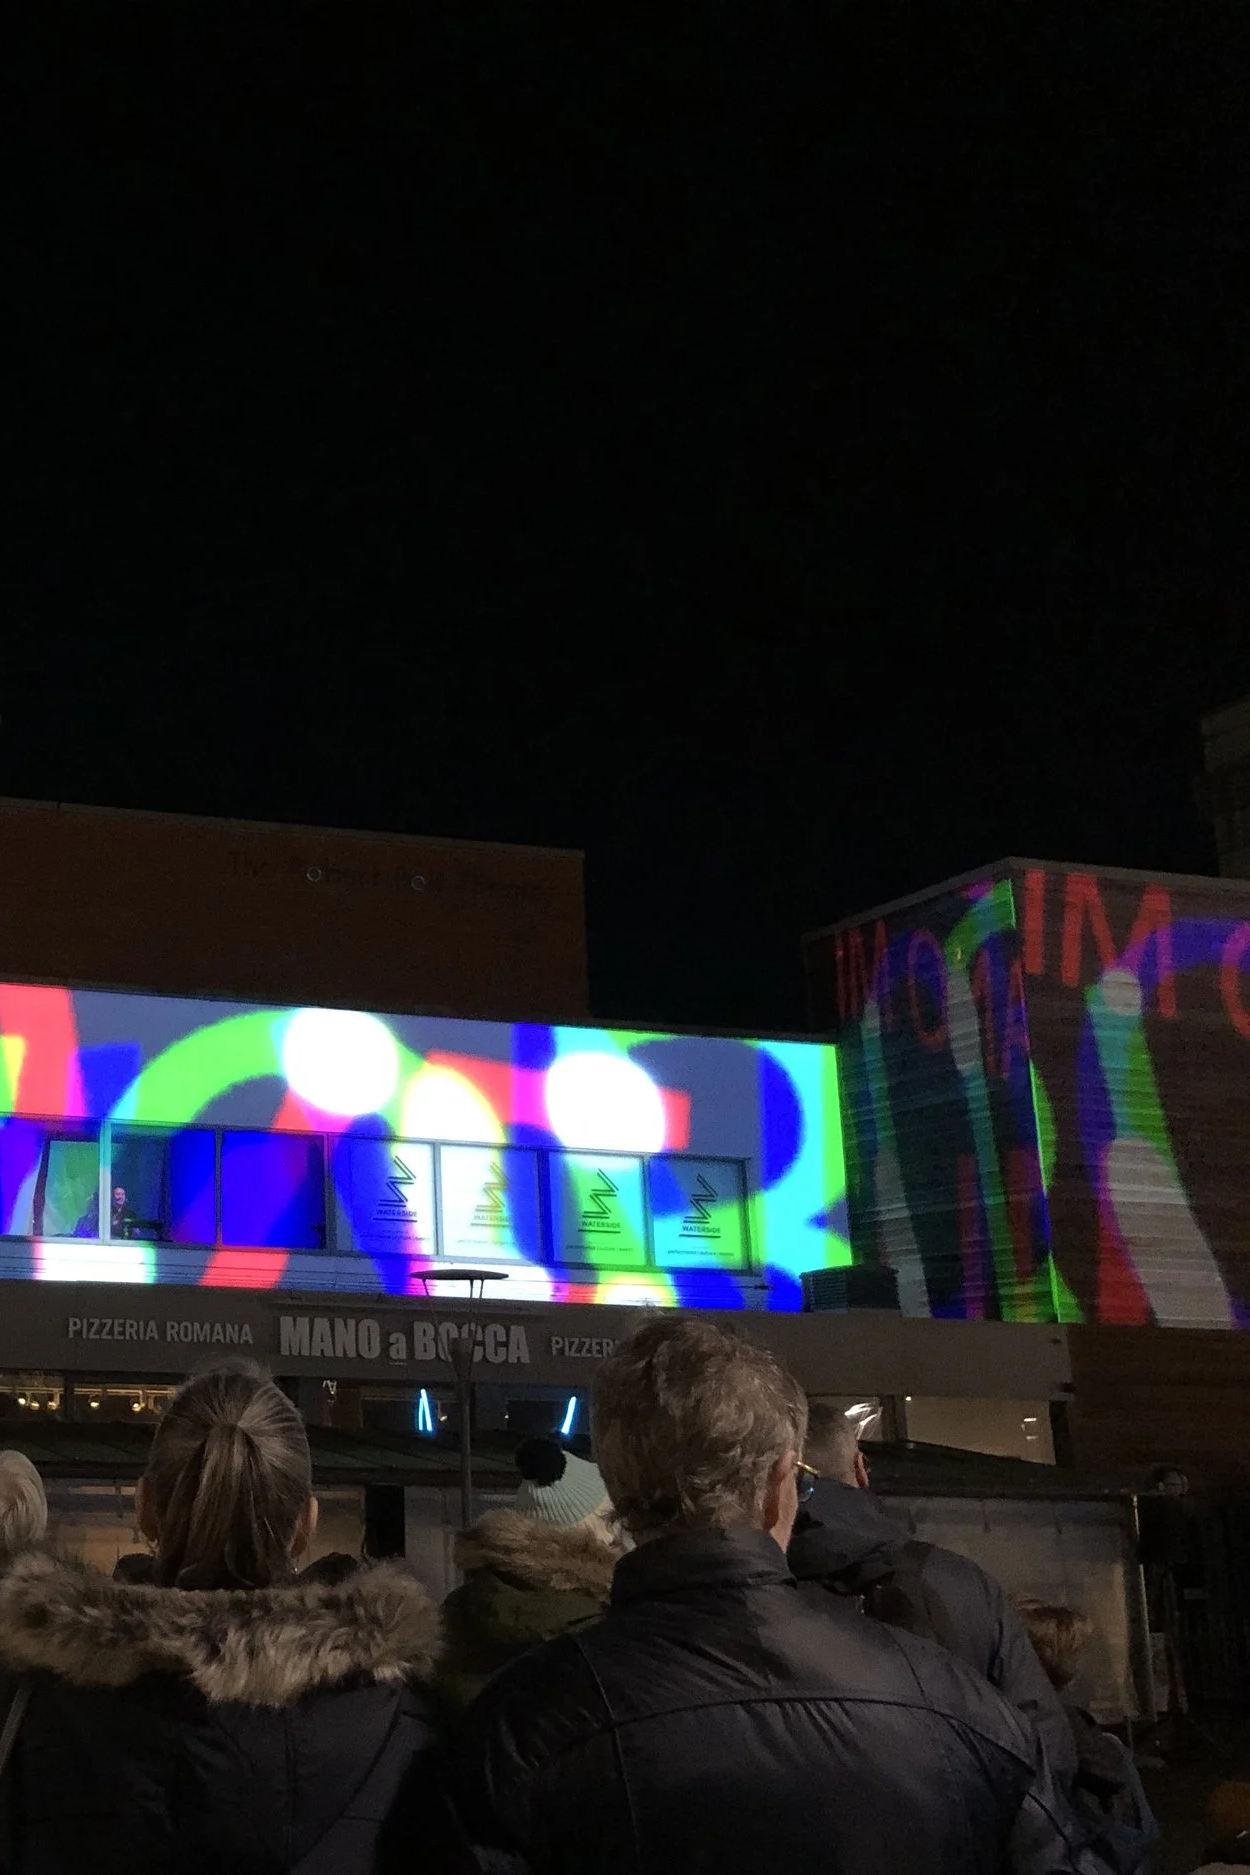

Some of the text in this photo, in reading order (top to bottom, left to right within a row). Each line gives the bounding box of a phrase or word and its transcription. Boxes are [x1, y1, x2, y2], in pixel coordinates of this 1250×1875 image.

[581, 1220, 621, 1229] WATERSIDE
[682, 1225, 721, 1234] WATERSIDE
[67, 1317, 159, 1341] PIZZERIA
[165, 1320, 253, 1345] ROMANA
[279, 1316, 381, 1359] MANO
[388, 1332, 408, 1366] a
[551, 1336, 620, 1358] PIZZER
